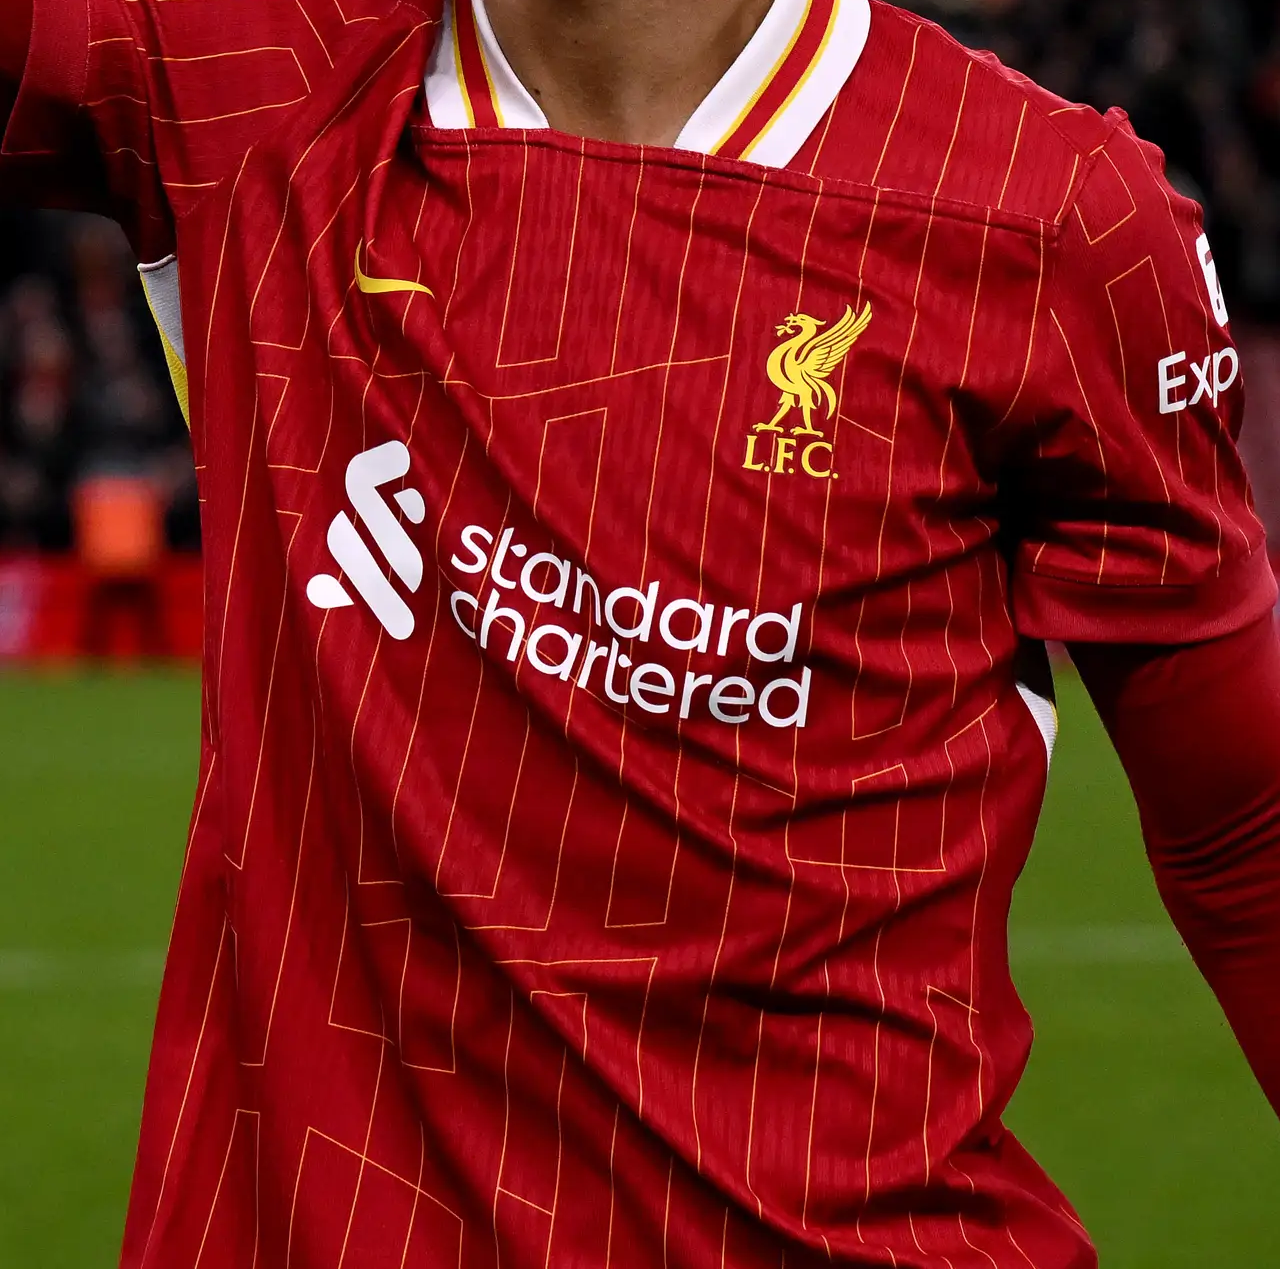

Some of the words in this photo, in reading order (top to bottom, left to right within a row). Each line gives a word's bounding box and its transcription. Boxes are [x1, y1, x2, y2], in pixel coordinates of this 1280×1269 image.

[742, 434, 840, 480] L.F.C.
[450, 523, 803, 663] standard
[450, 587, 812, 728] chartered
